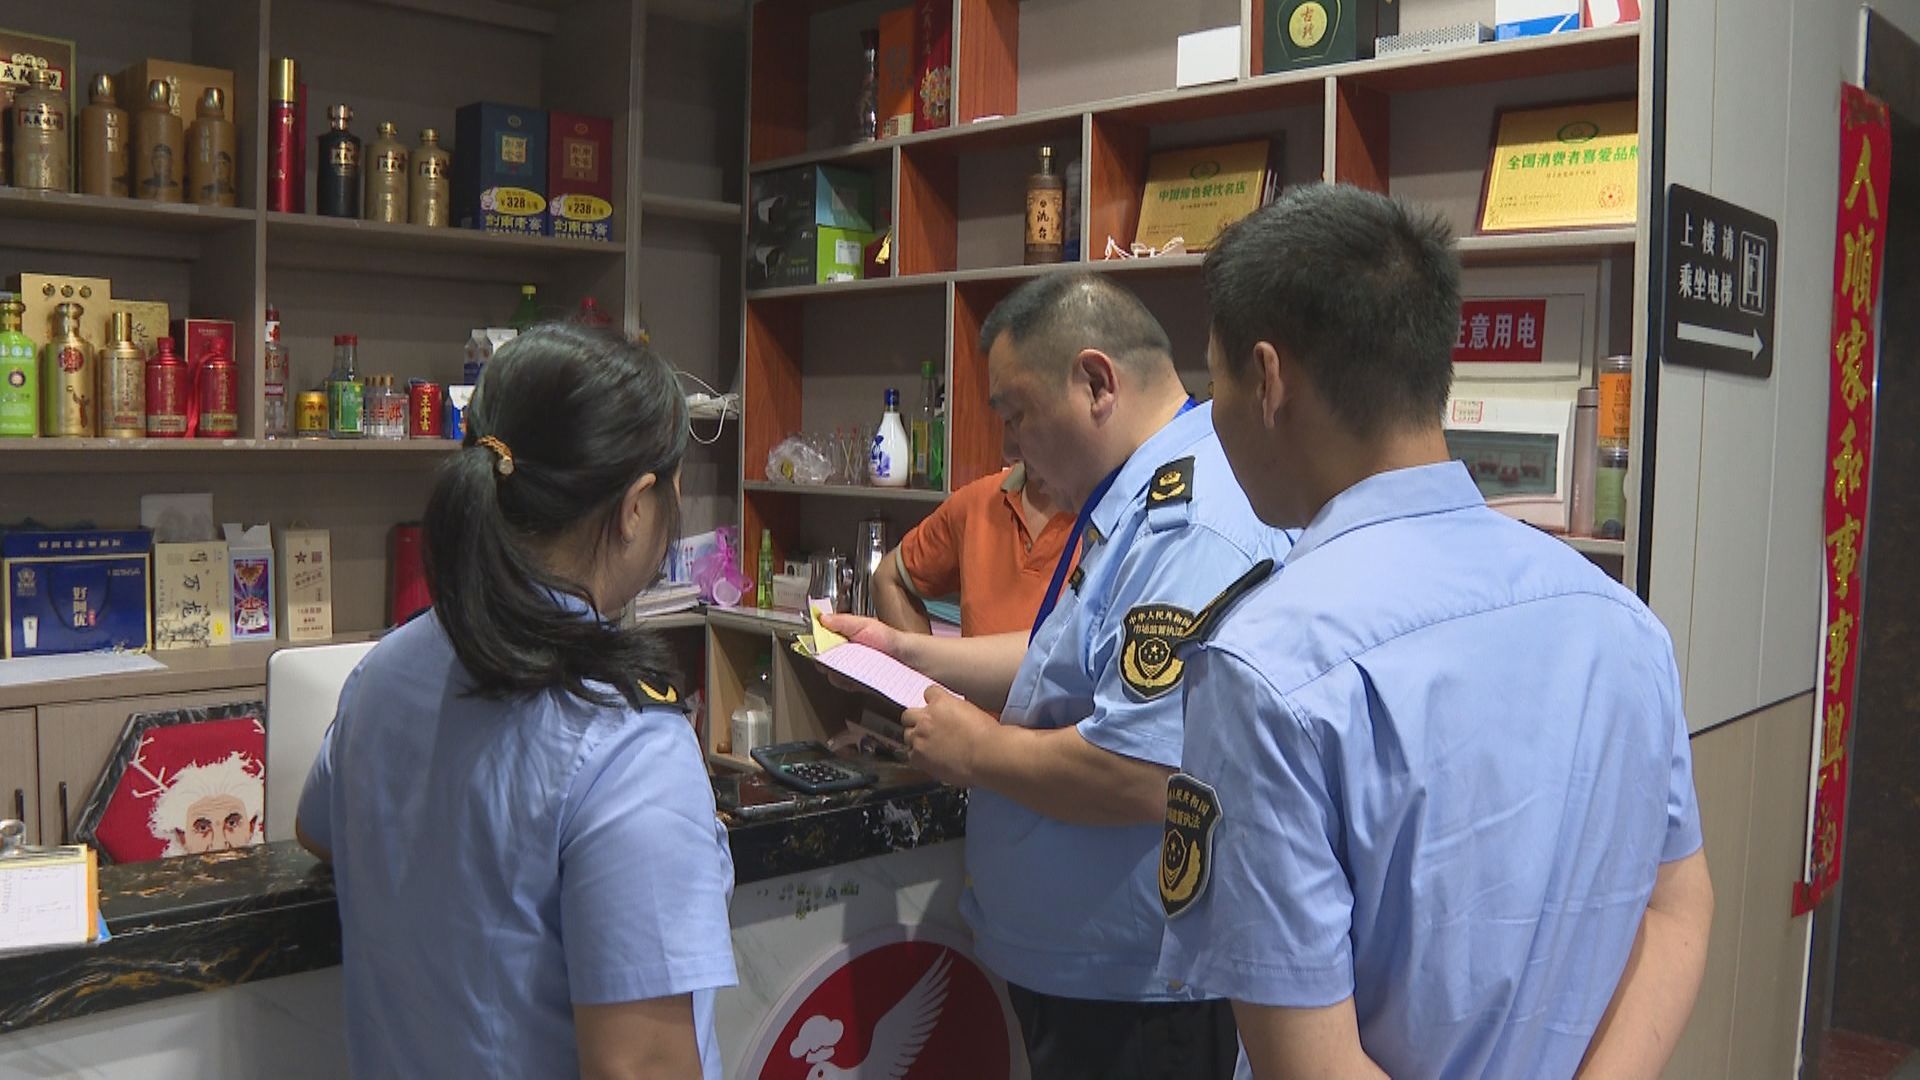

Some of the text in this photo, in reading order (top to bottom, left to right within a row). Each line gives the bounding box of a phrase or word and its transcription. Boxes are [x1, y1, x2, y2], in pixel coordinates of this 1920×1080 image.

[1680, 212, 1734, 262] 上楼请
[1678, 262, 1733, 308] 乘坐电梯
